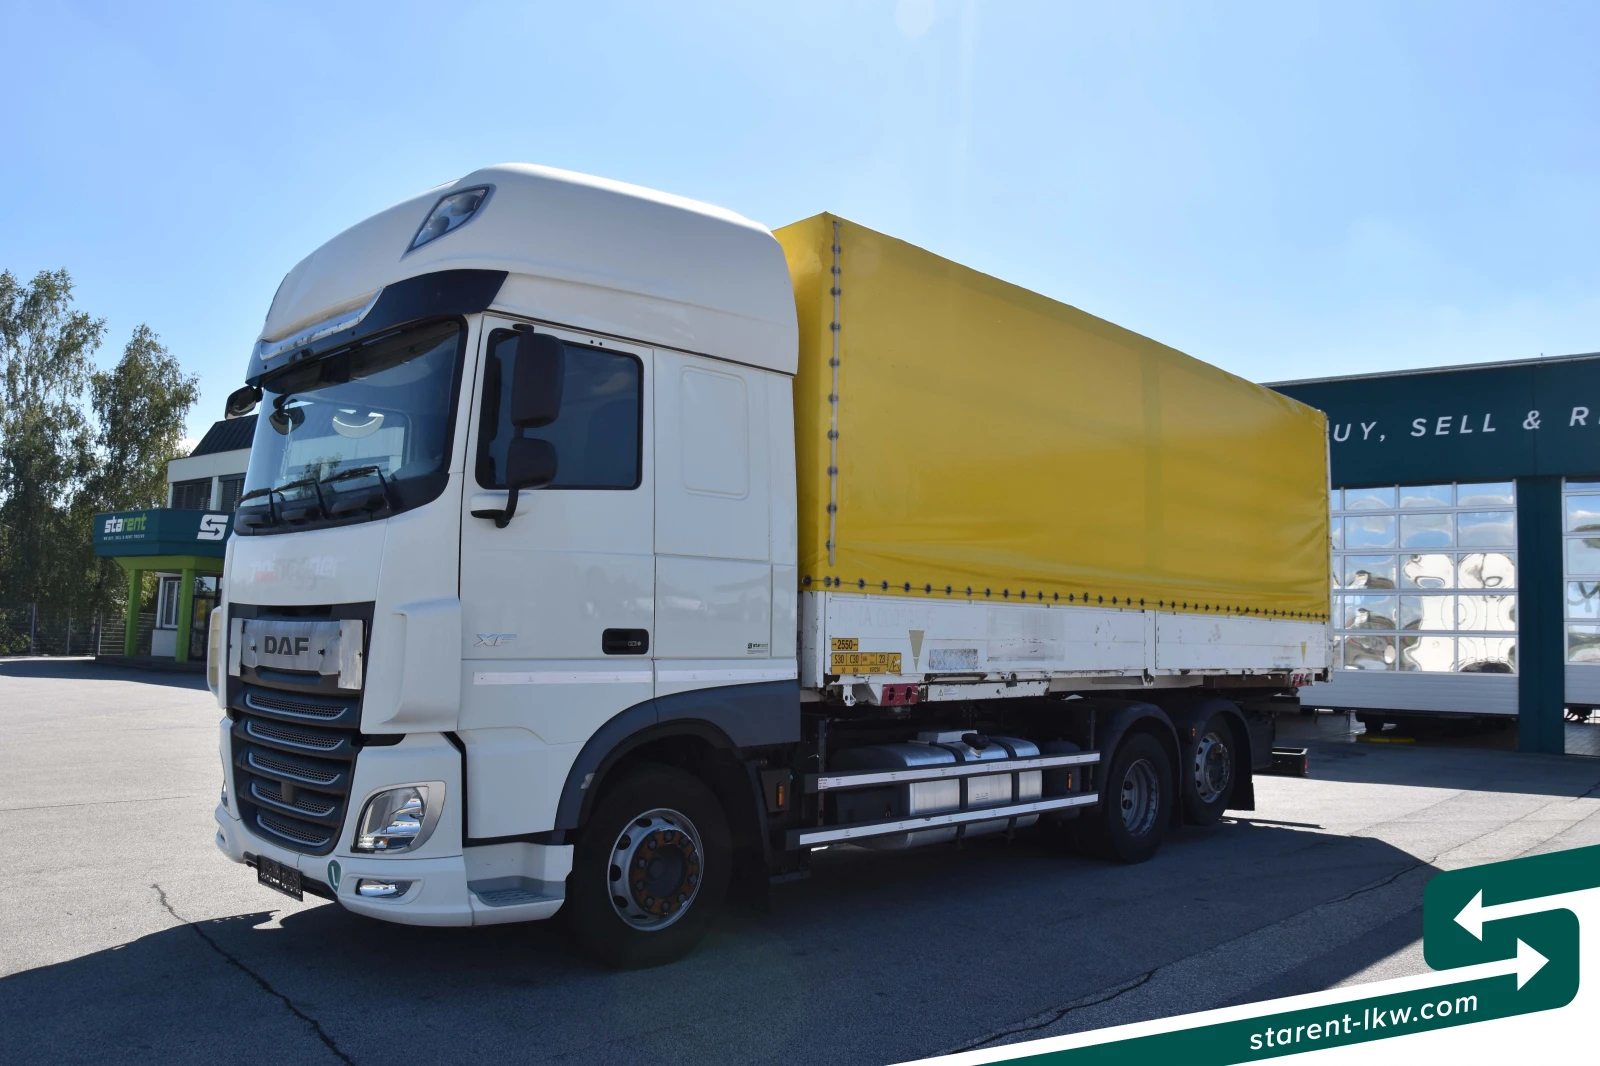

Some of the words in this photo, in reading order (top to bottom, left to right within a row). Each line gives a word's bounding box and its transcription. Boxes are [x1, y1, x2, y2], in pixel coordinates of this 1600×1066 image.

[1410, 413, 1496, 437] SELL
[1522, 410, 1541, 430] &
[1569, 406, 1600, 427] R
[104, 513, 147, 534] starent
[264, 635, 310, 656] DAF
[473, 633, 518, 647] XF
[837, 639, 853, 650] 2550
[849, 654, 860, 664] C30
[879, 654, 886, 664] 23
[331, 866, 338, 886] L
